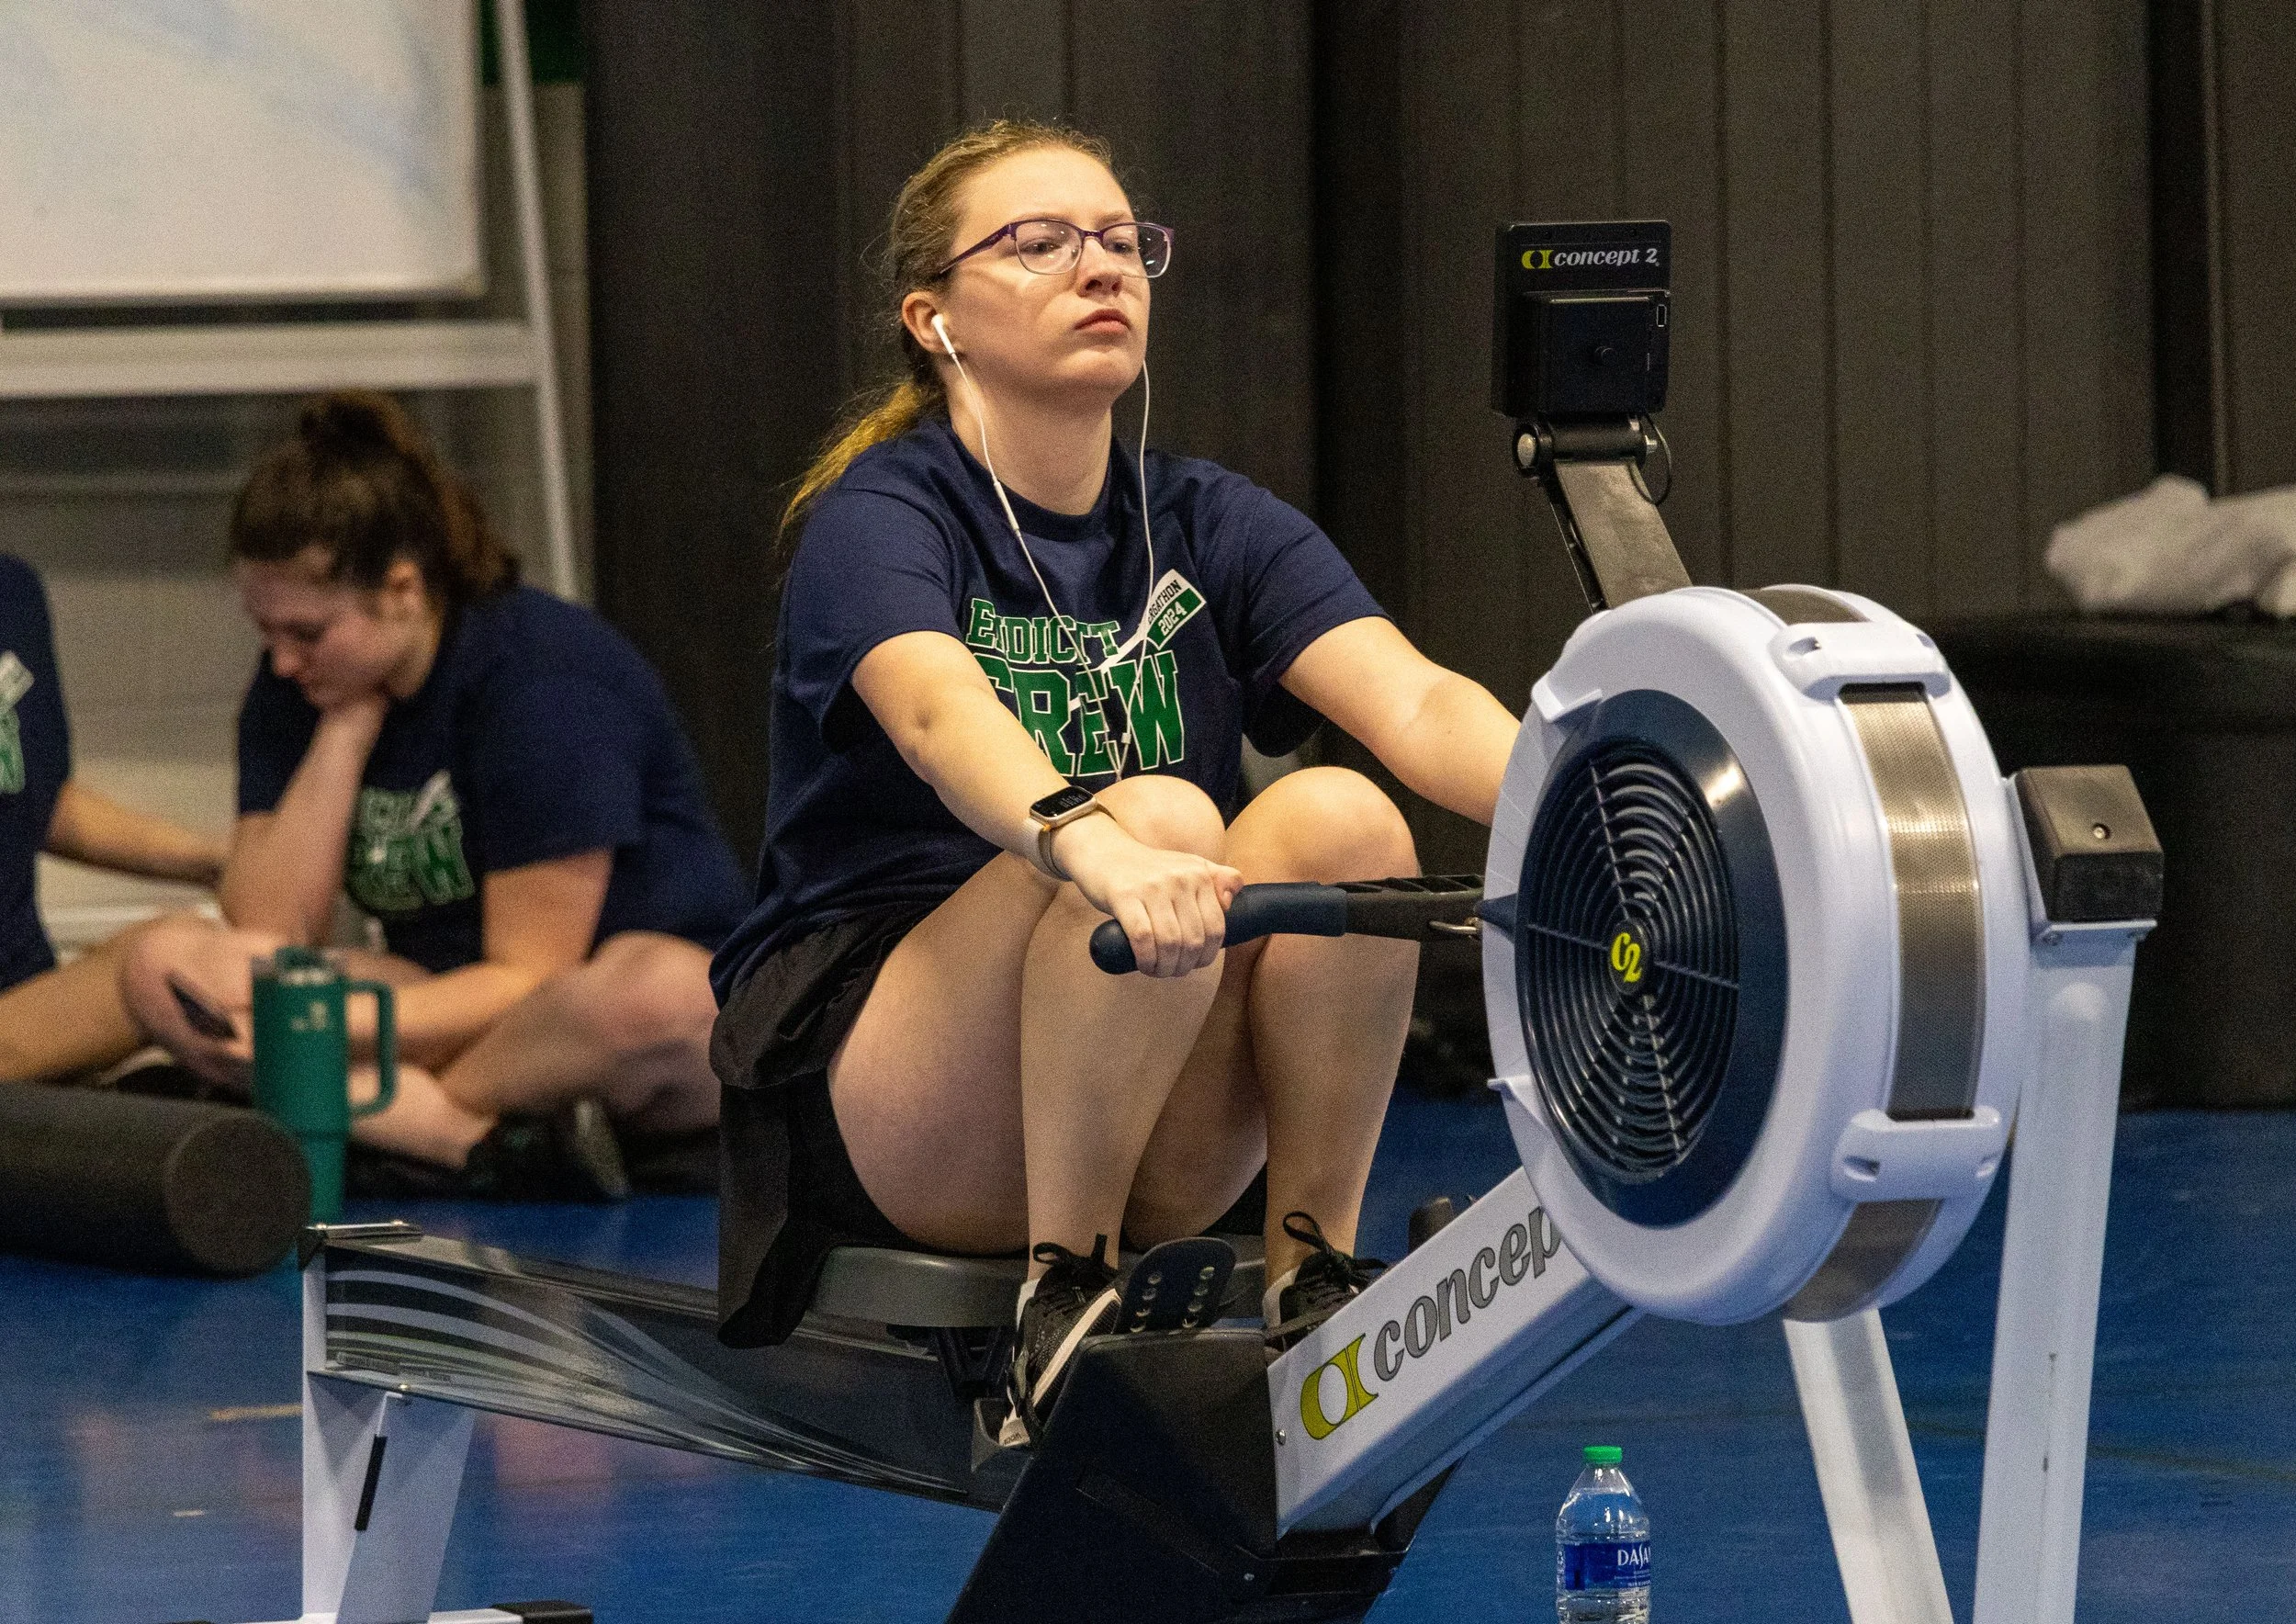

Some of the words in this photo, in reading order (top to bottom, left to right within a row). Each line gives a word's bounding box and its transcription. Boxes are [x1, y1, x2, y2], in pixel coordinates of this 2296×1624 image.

[1554, 249, 1640, 266] concept
[1645, 247, 1659, 265] 2
[1158, 601, 1187, 637] 2024
[1611, 931, 1642, 983] C2
[1617, 1543, 1651, 1569] DASA
